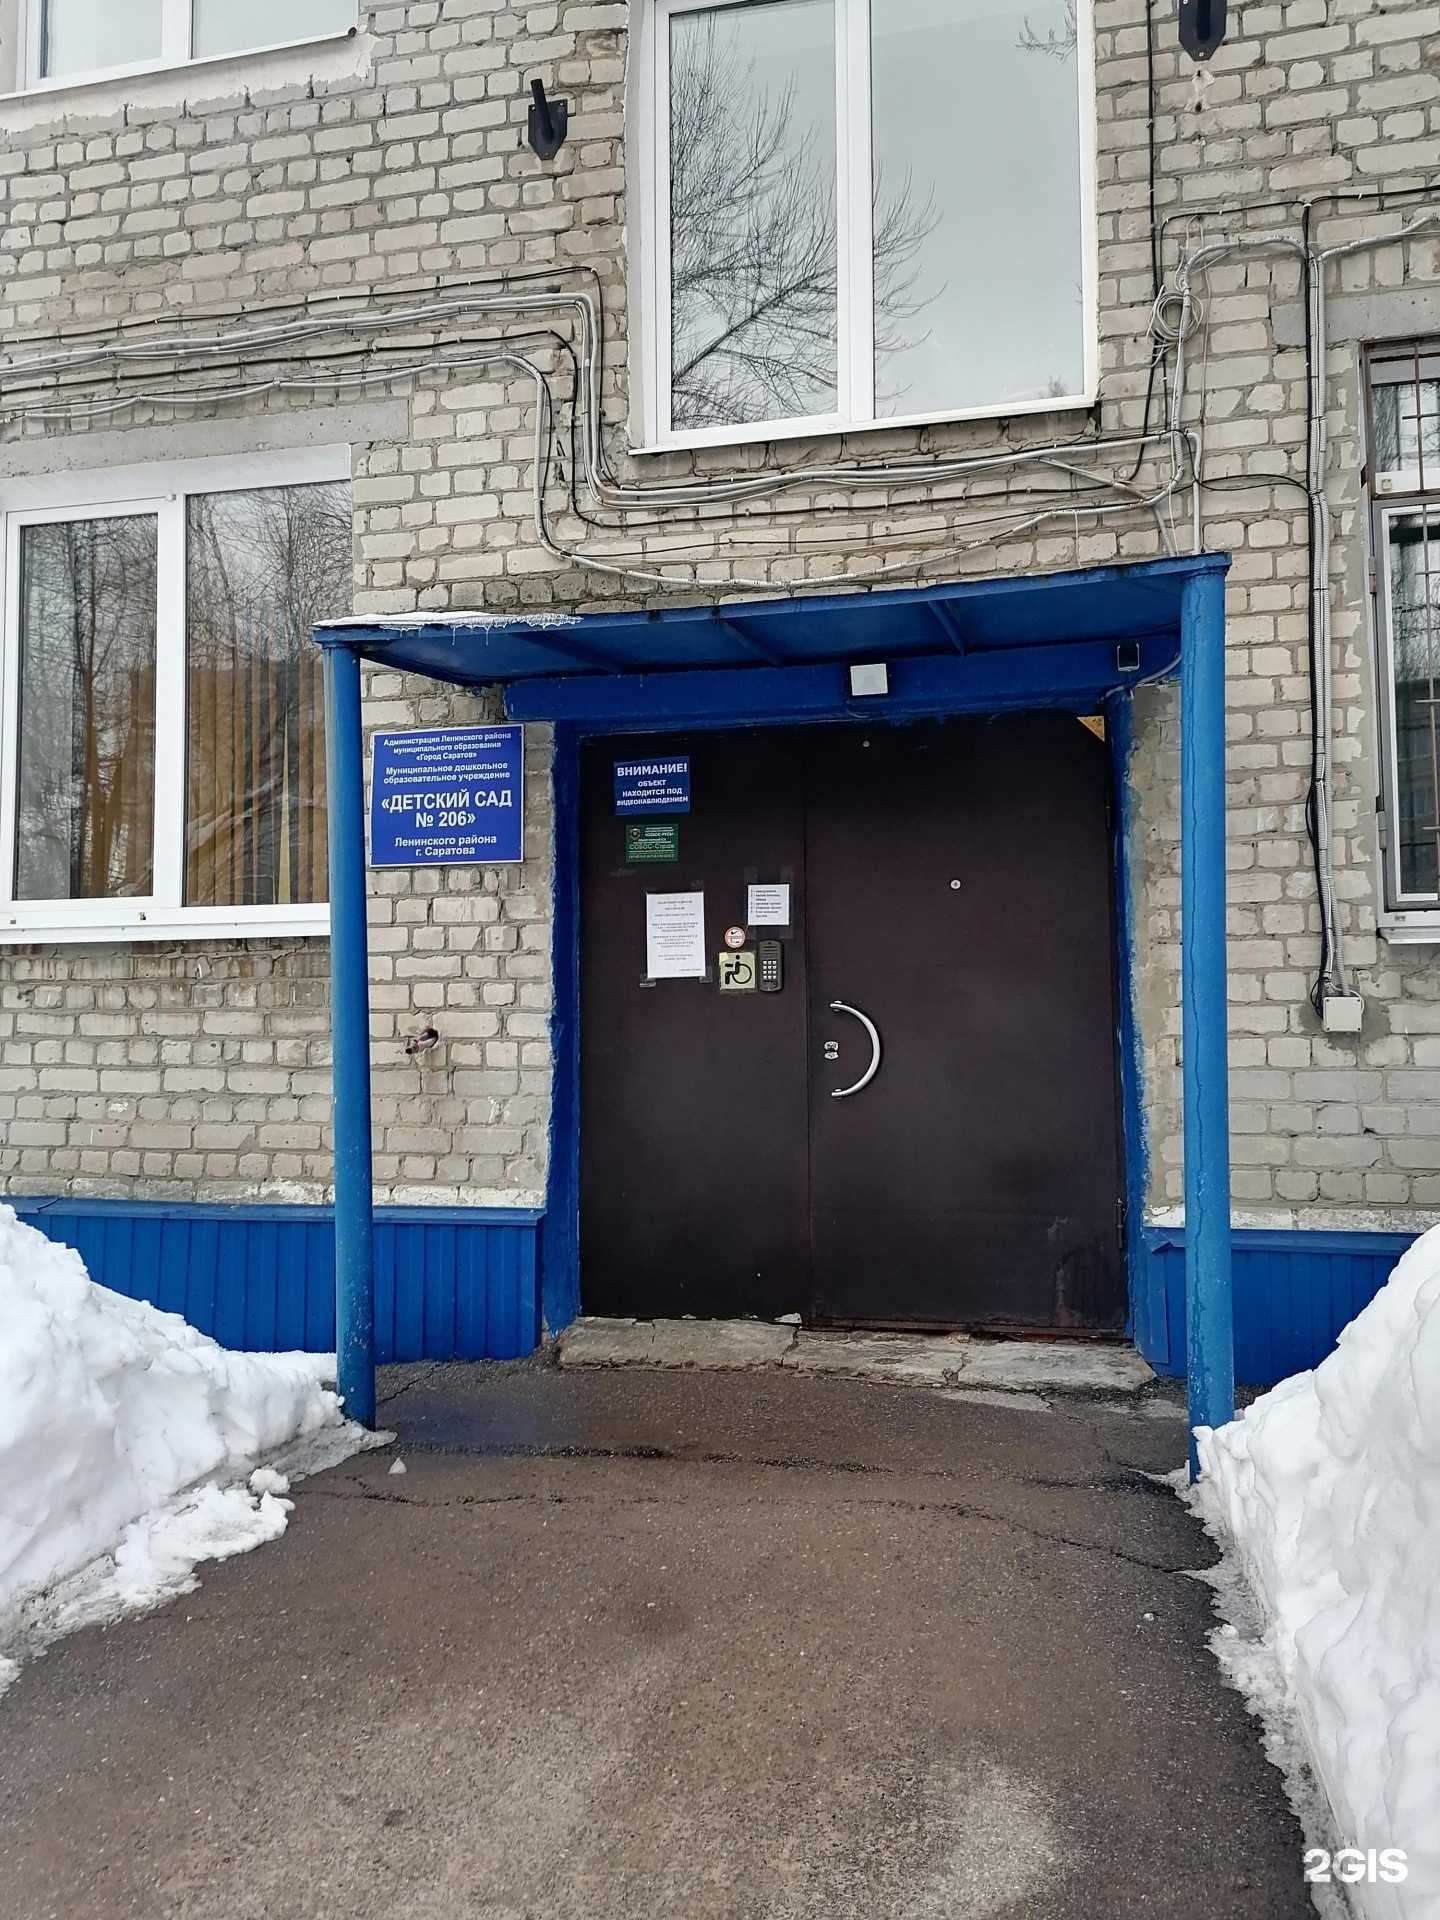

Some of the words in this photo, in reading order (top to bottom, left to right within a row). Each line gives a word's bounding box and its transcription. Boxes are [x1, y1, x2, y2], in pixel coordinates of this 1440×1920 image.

[384, 737, 440, 747] Администрация
[441, 735, 483, 744] Ленинского
[484, 732, 511, 742] района
[393, 744, 452, 755] муниципального
[453, 741, 501, 751] образования
[416, 753, 441, 762] «Город
[443, 751, 477, 761] Саратов»
[385, 764, 453, 776] Муниципальное
[454, 762, 508, 773] дошкольное
[617, 763, 687, 777] ВНИМАНИЕ!
[383, 773, 456, 785] образовательное
[458, 771, 511, 783] учреждение
[638, 779, 667, 788] ОБЪЕКТ
[622, 788, 665, 798] НАХОДИТСЯ
[666, 787, 683, 796] ПОД
[381, 788, 470, 813] «ДЕТСКИЙ
[474, 789, 513, 808] САД
[616, 796, 688, 806] ВИДЕОНАБЛЮДЕНИЕМ
[415, 812, 434, 829] №
[438, 811, 476, 828] 206»
[394, 836, 456, 848] Ленинского
[458, 834, 497, 847] района
[415, 848, 422, 857] г.
[424, 846, 476, 859] Саратова
